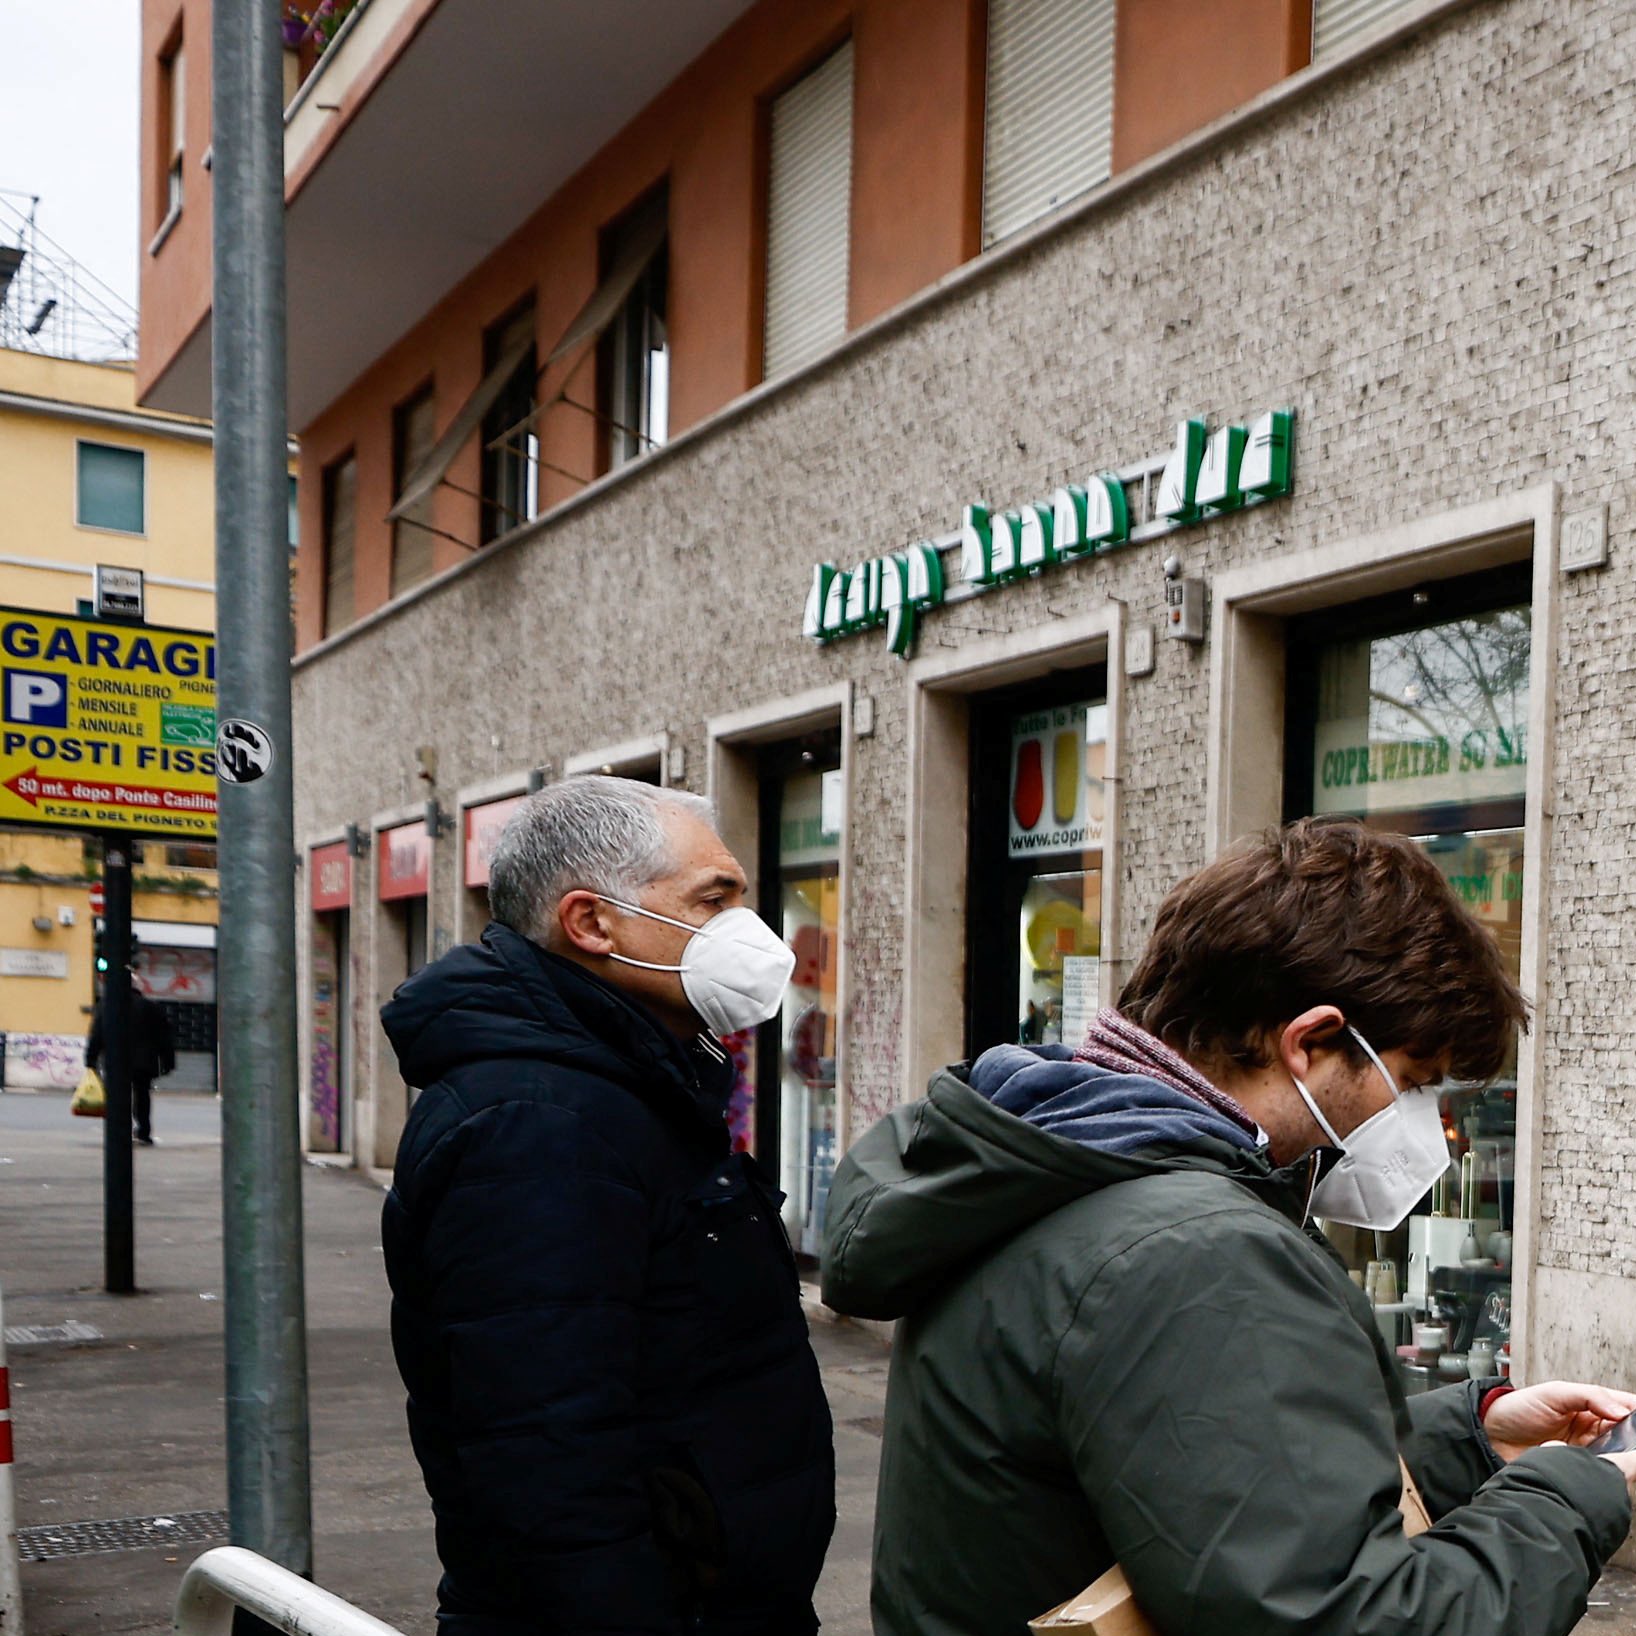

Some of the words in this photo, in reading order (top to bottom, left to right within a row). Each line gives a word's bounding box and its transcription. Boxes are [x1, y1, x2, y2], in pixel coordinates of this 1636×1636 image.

[1568, 516, 1596, 556] 126
[11, 672, 62, 720] P
[78, 676, 171, 700] GIORNALIERO
[78, 697, 137, 716] MENSILE
[78, 718, 144, 737] ANNUALE
[4, 731, 121, 766] POSTI
[18, 777, 39, 794] 50
[73, 783, 111, 803] dopo
[115, 787, 161, 805] Ponte
[96, 808, 127, 822] DEL
[133, 813, 205, 829] PIGNETO
